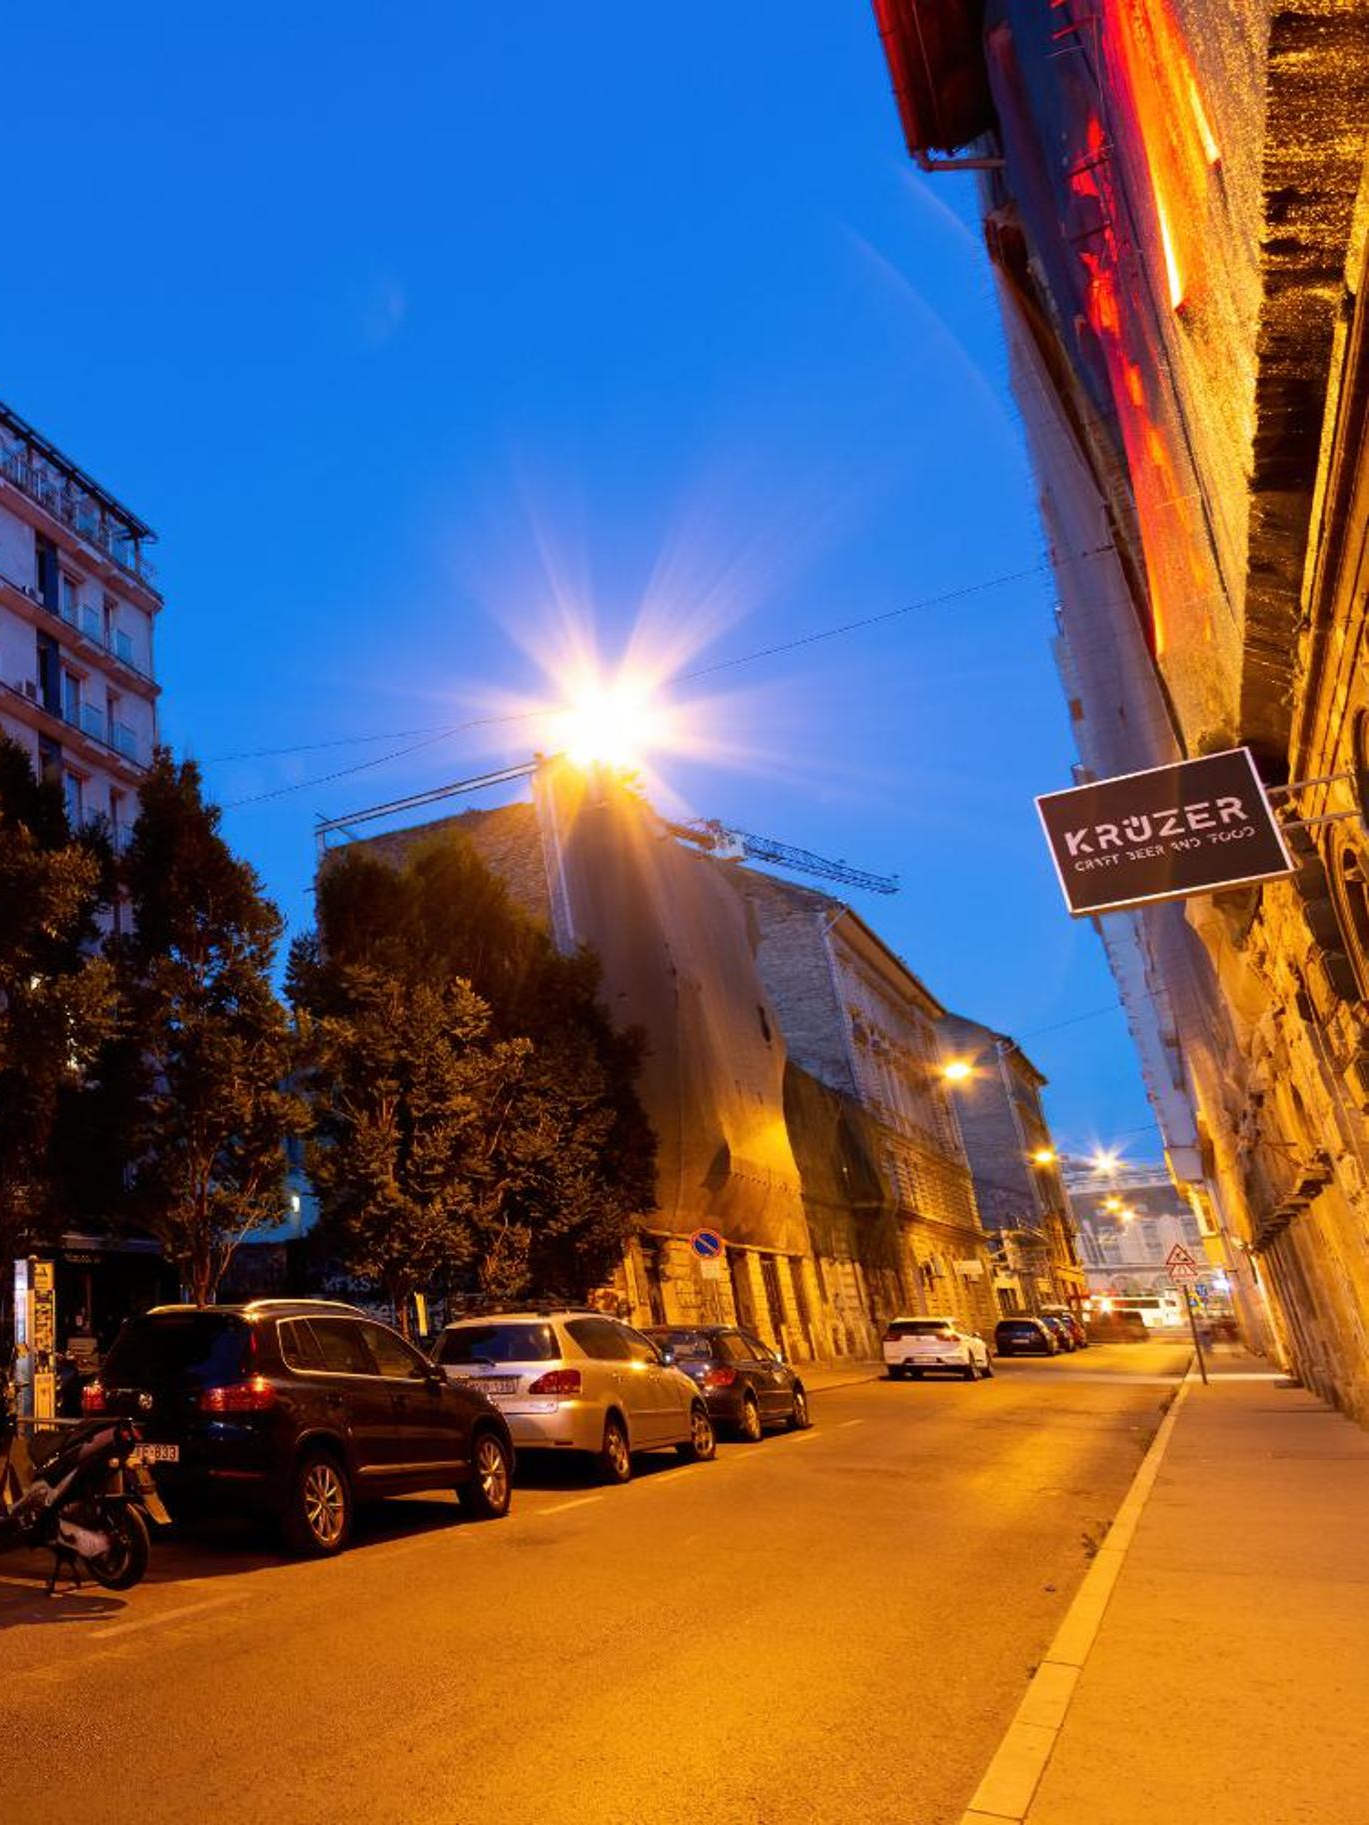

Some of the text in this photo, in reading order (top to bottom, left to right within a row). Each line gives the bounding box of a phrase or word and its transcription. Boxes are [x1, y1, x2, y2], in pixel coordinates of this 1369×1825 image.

[1064, 796, 1248, 856] KRÜZER
[1074, 826, 1255, 872] CRAFT BEER AND FOOD
